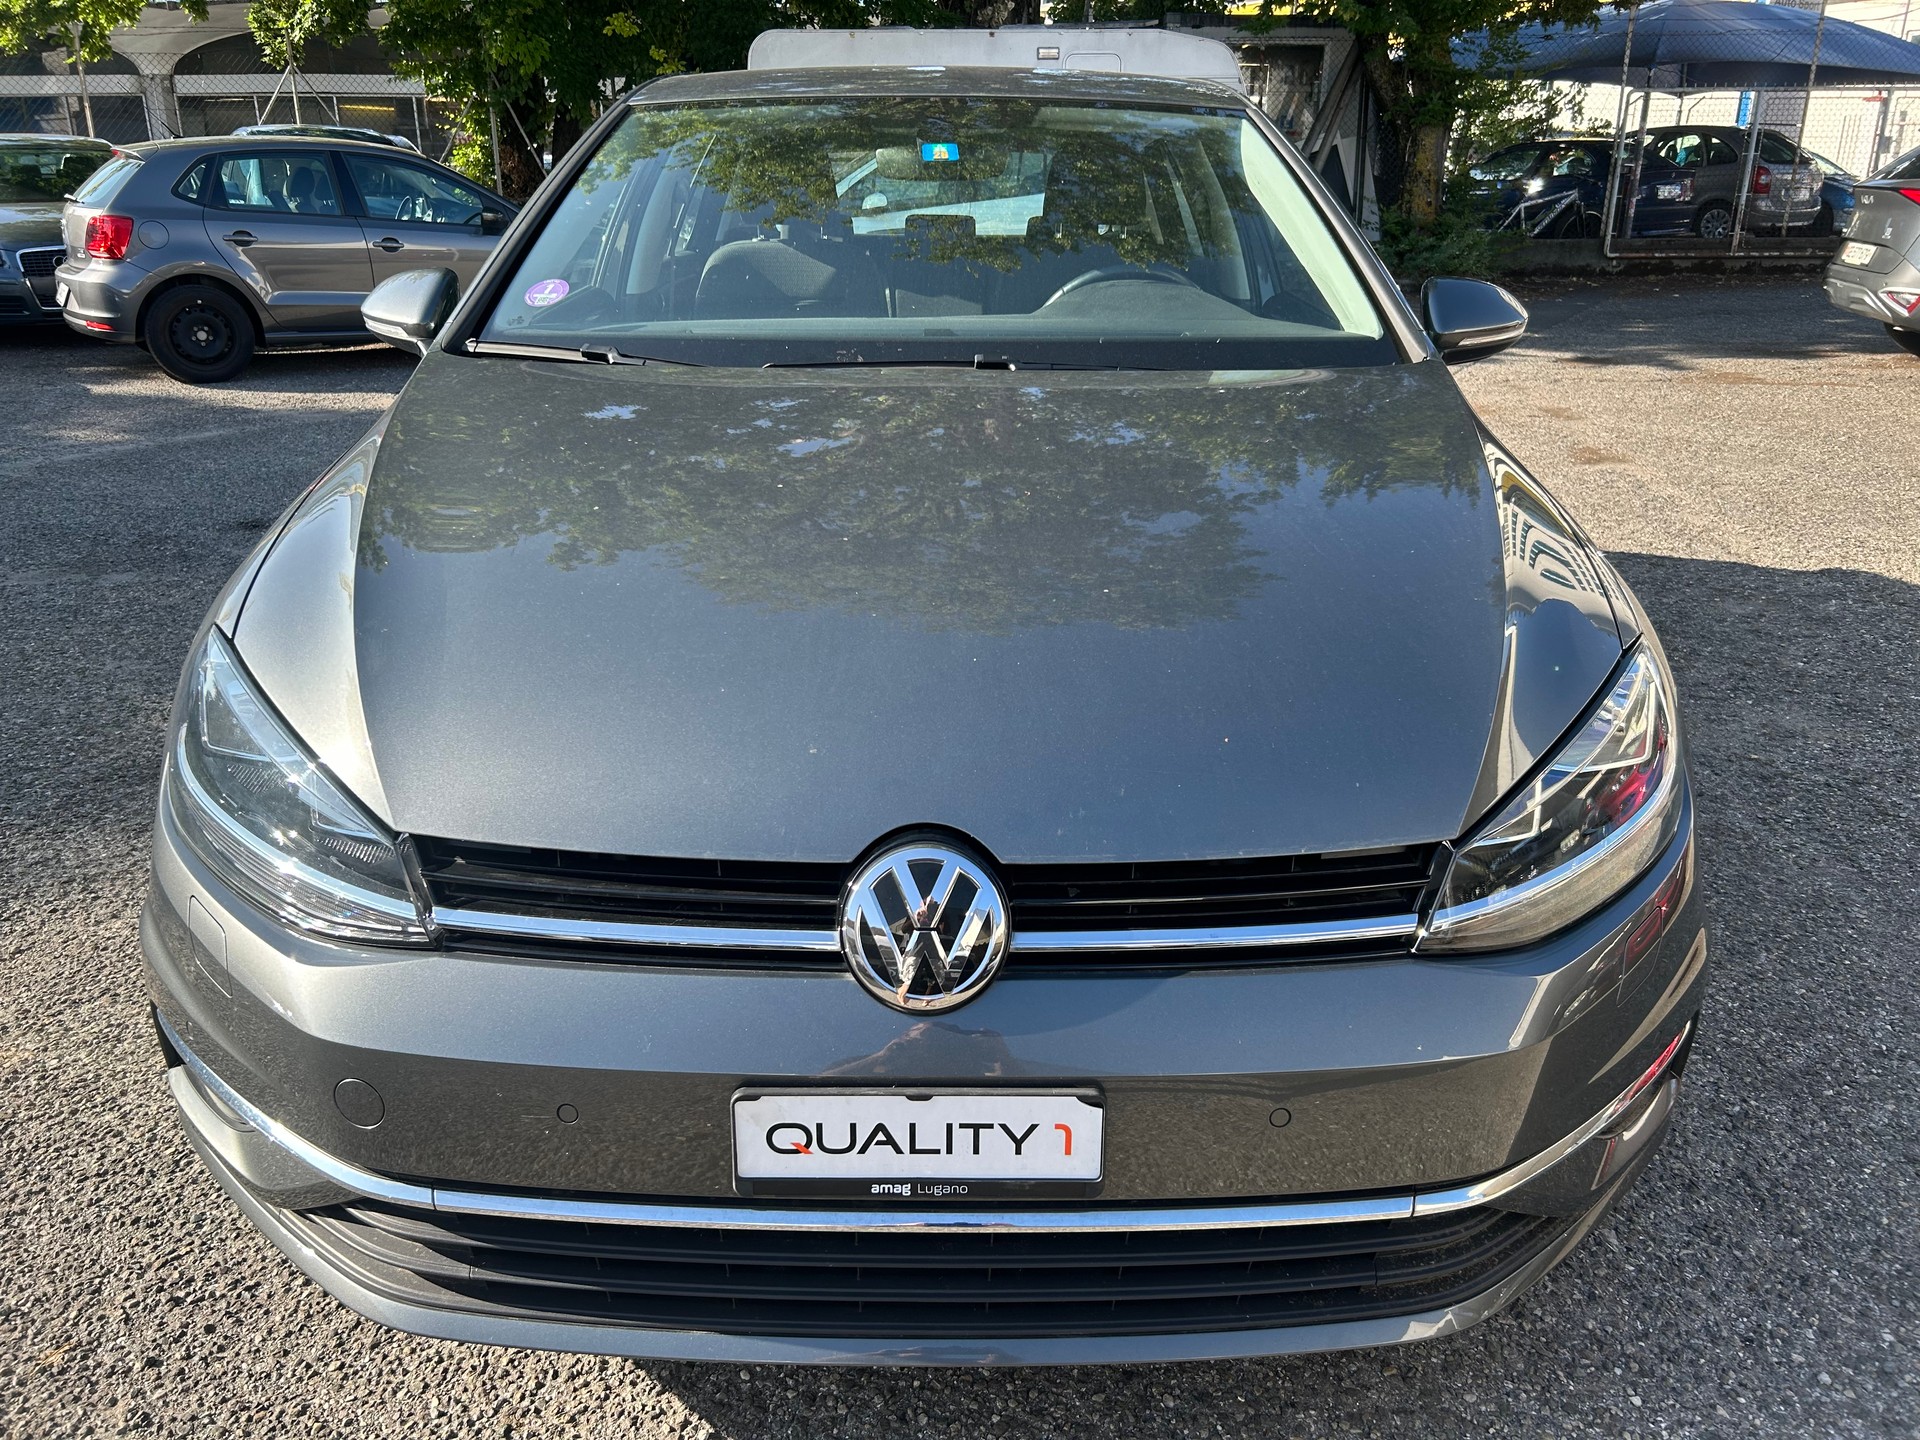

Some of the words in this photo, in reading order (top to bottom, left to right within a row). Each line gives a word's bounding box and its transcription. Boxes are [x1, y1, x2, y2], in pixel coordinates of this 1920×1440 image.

[765, 1122, 1040, 1155] QUALITY
[1054, 1123, 1072, 1155] 1
[871, 1183, 911, 1196] amag
[917, 1183, 968, 1196] Lugano
